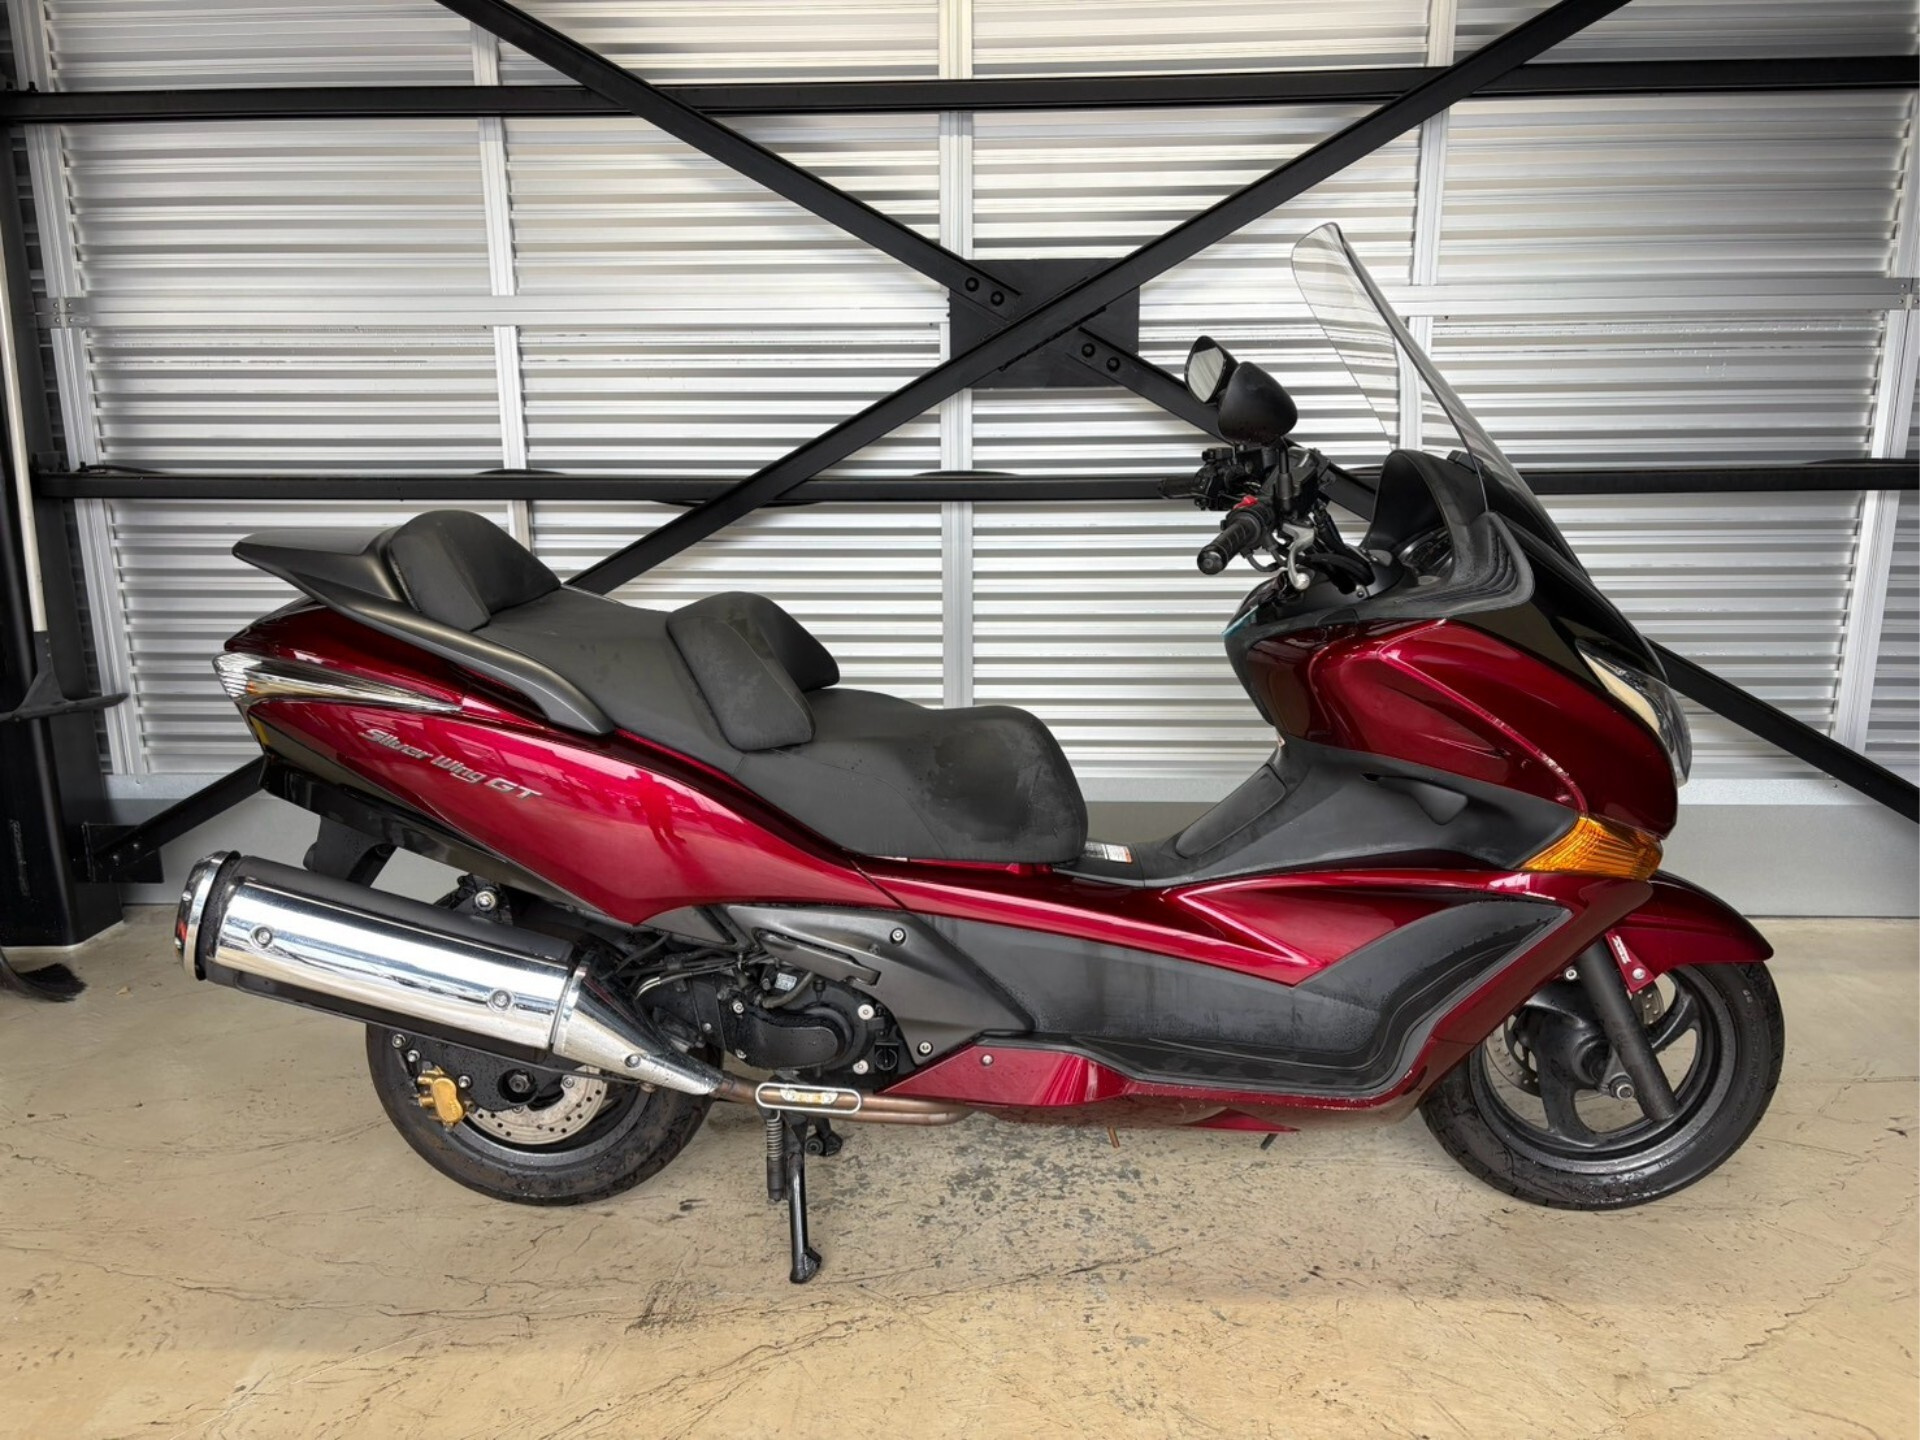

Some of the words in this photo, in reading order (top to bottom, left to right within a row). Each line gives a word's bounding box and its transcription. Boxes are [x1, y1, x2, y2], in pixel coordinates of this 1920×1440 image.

[357, 728, 433, 760] Silver
[430, 755, 487, 784] Wing
[484, 777, 543, 799] GT
